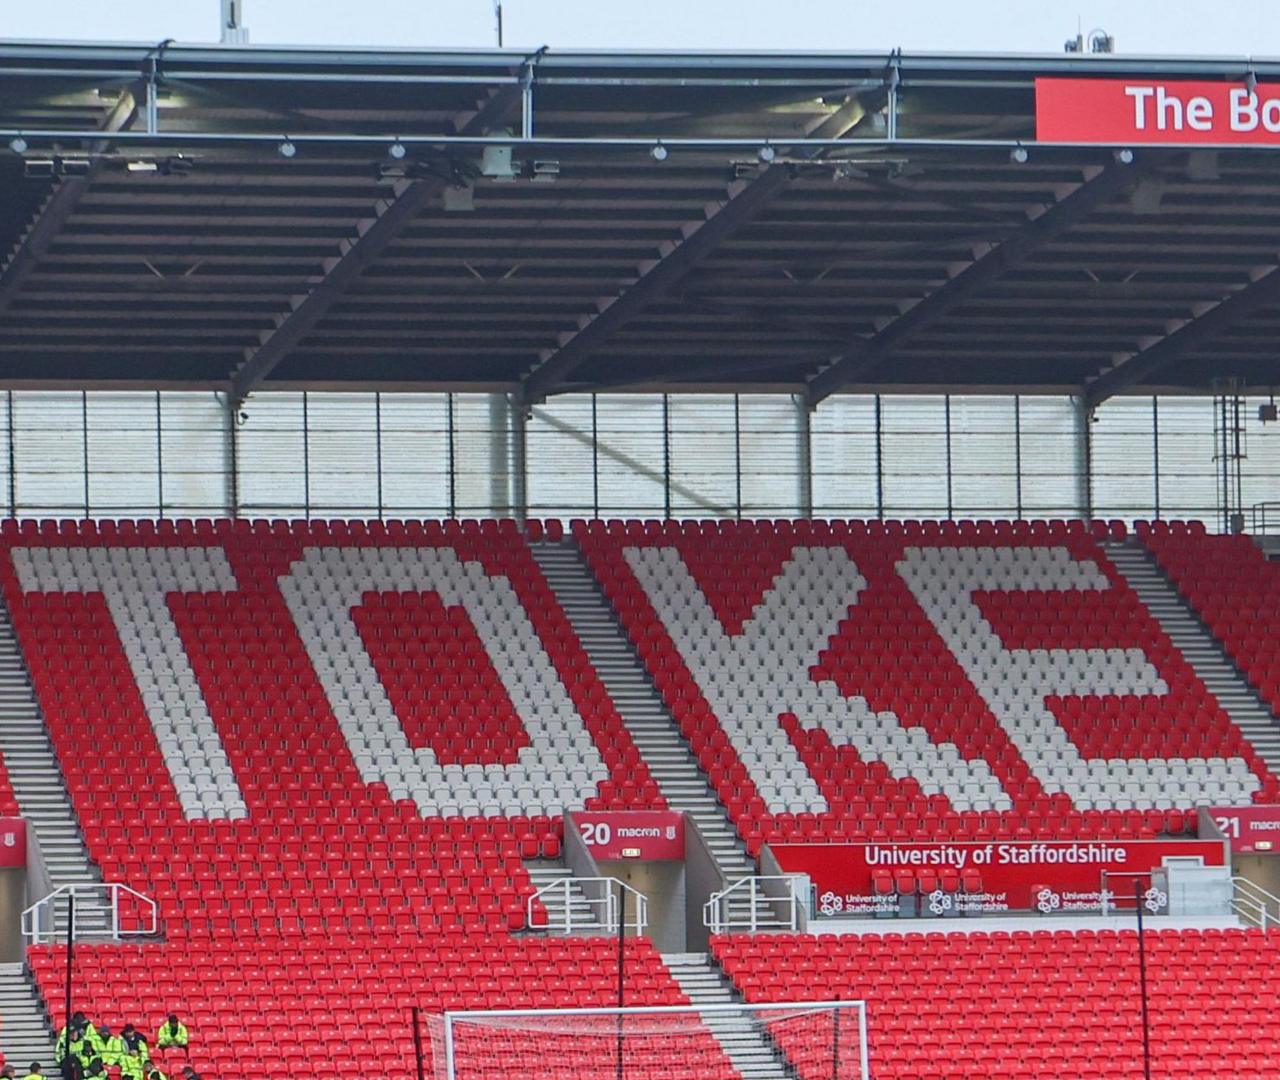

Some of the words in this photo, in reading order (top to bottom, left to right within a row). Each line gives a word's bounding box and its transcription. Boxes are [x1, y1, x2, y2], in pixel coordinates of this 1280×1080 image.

[1124, 86, 1213, 131] The
[580, 823, 610, 845] 20
[617, 827, 660, 837] macron
[1216, 817, 1239, 838] 21
[864, 845, 967, 868] University
[973, 844, 993, 864] of
[998, 844, 1127, 864] Staffordshire
[846, 894, 889, 904] University
[890, 893, 899, 902] of
[954, 892, 996, 903] University
[997, 892, 1006, 901] of
[846, 902, 900, 913] Staffordshire
[954, 901, 1008, 912] Staffordshire
